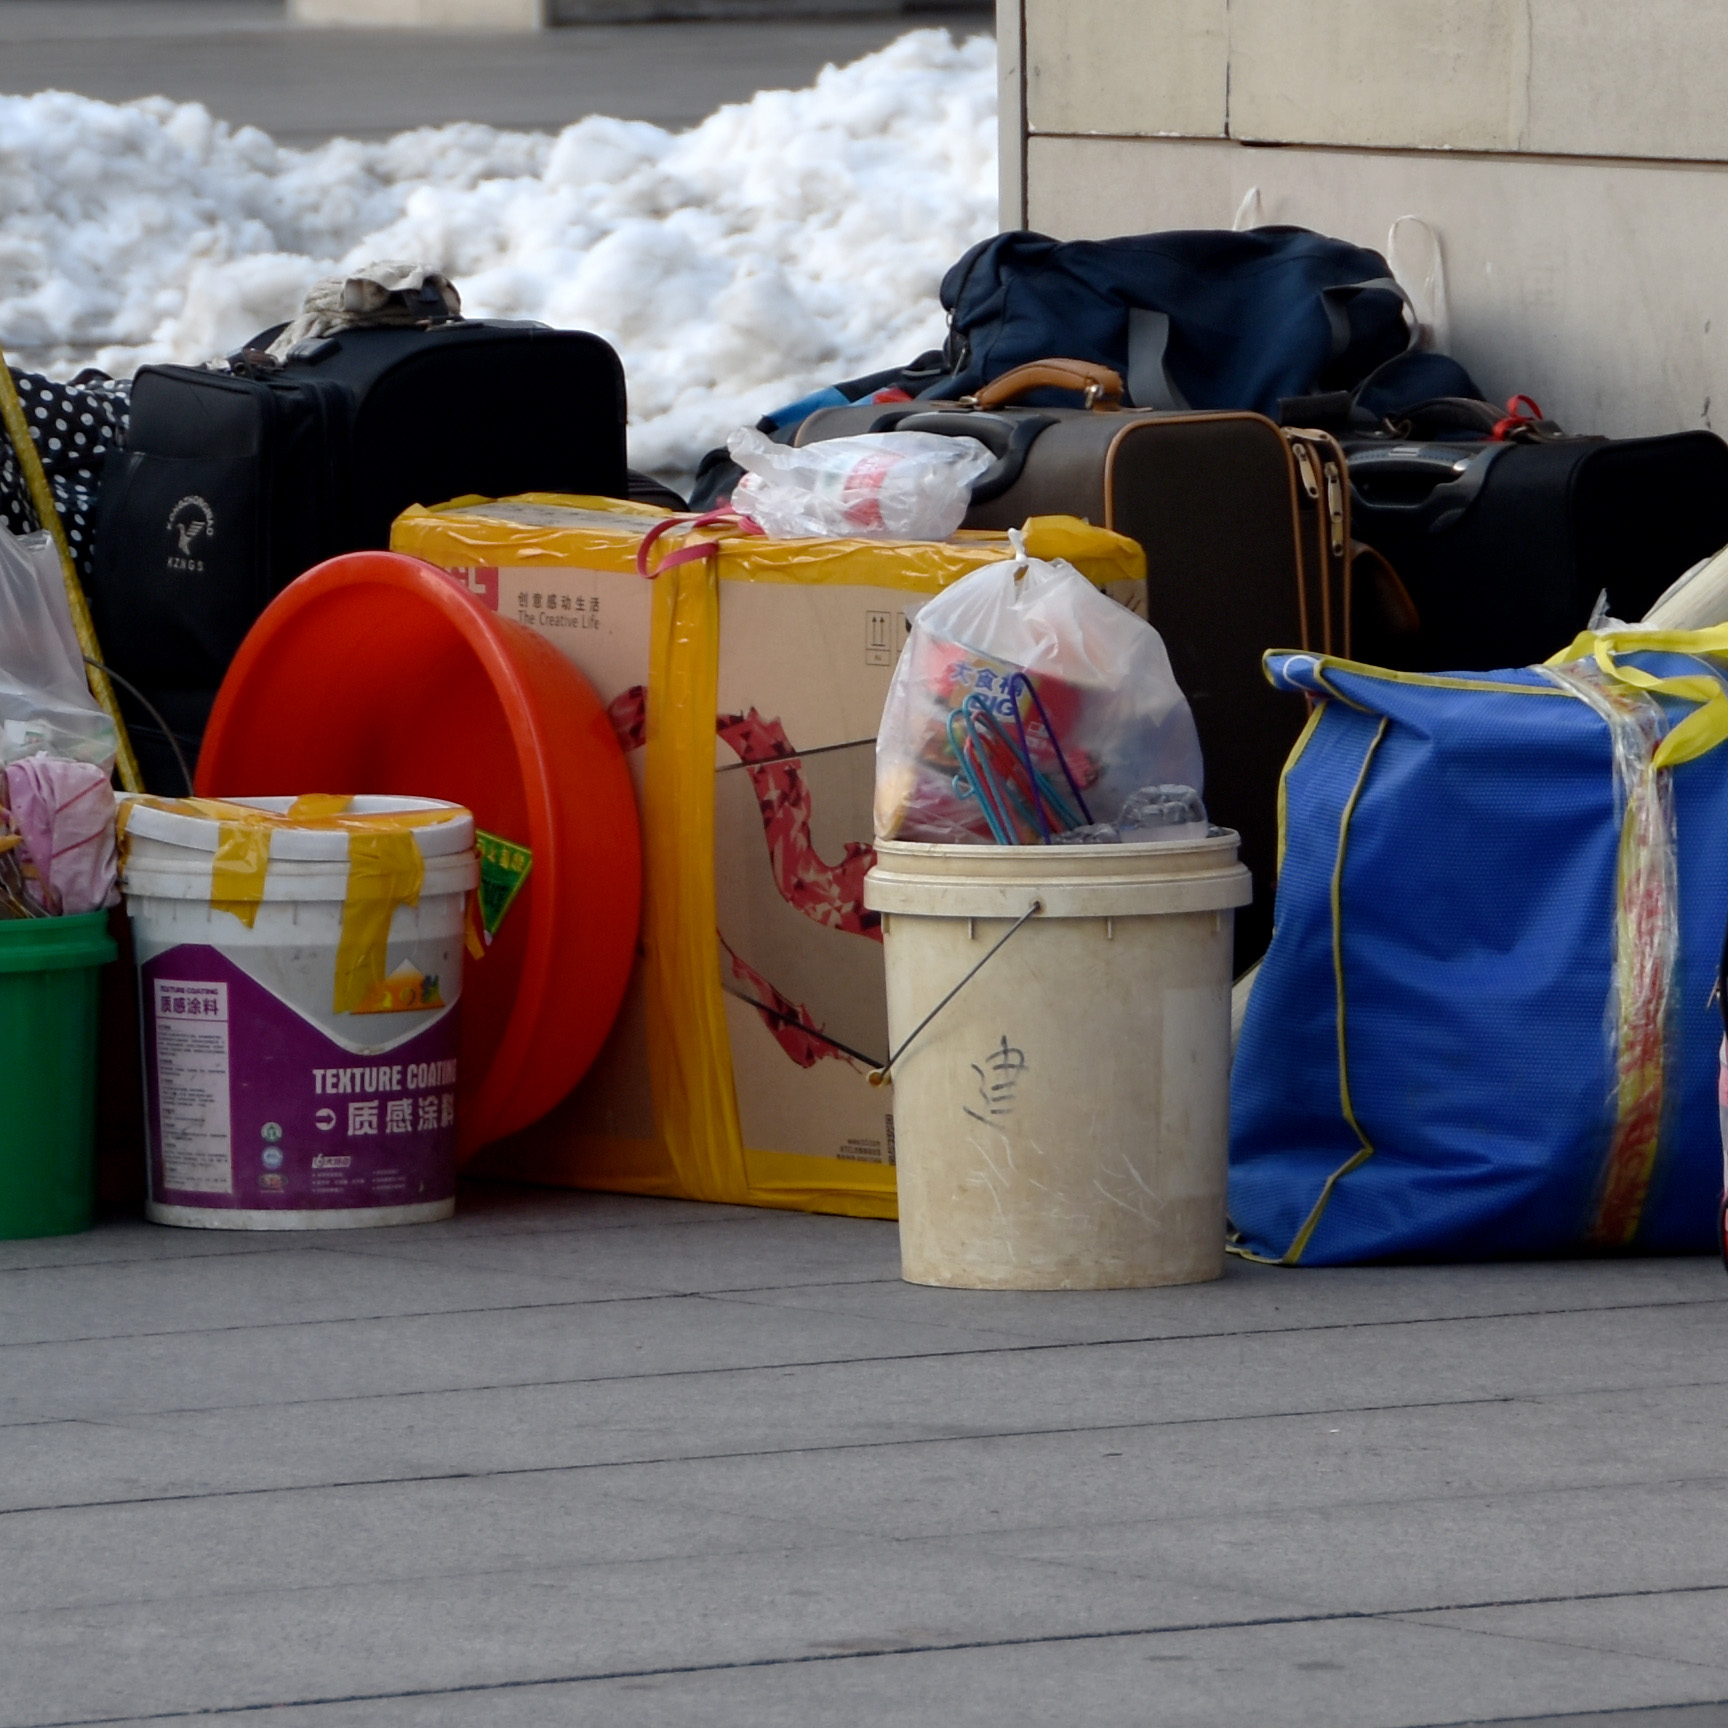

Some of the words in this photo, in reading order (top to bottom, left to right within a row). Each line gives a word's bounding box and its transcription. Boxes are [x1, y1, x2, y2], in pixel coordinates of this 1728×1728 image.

[517, 591, 601, 613] 创意感动生活
[517, 609, 536, 626] The
[539, 611, 579, 628] Creative
[581, 613, 601, 630] Life
[160, 995, 220, 1016] 质感涂料
[313, 1065, 402, 1095] TEXTURE
[407, 1058, 458, 1090] COATIN
[347, 1093, 455, 1137] 质感涂料
